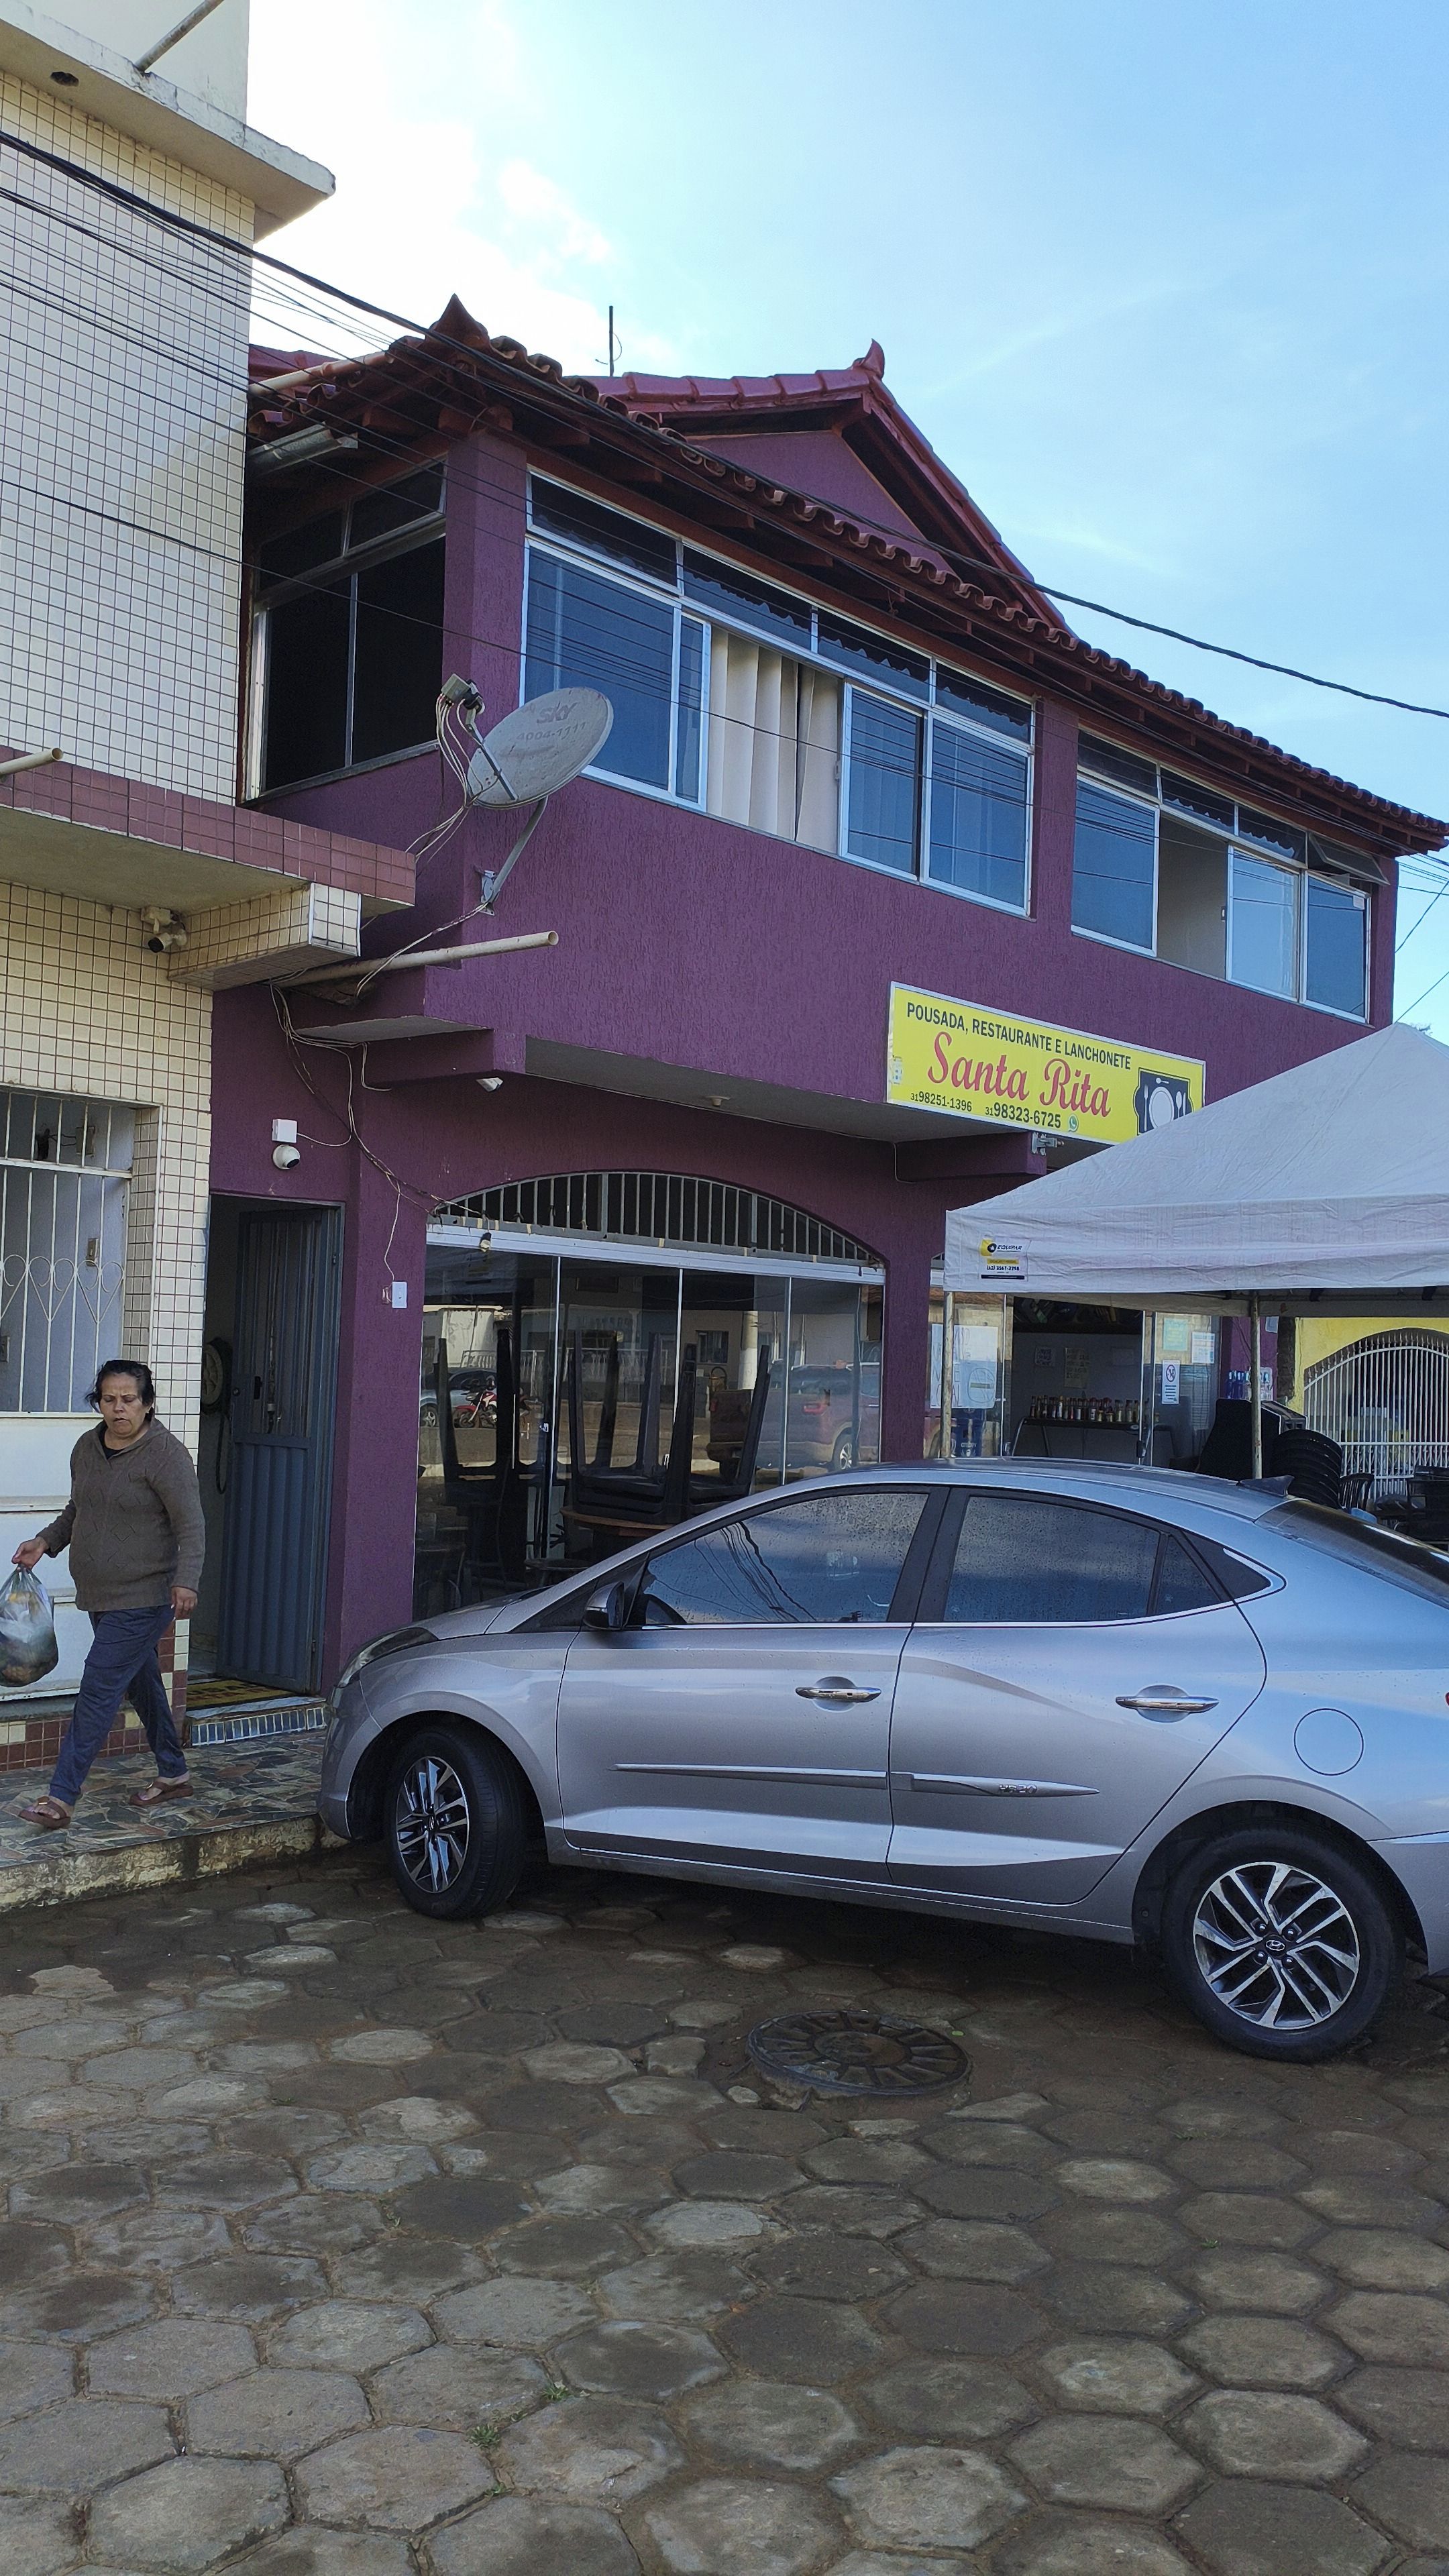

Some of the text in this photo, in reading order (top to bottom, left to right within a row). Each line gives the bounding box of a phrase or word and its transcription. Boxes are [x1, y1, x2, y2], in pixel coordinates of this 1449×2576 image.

[537, 701, 579, 723] SKY
[908, 1002, 1131, 1071] POUSADA, RESTAURANTE E LANCHONETE
[928, 1031, 1112, 1118] Santa Rita
